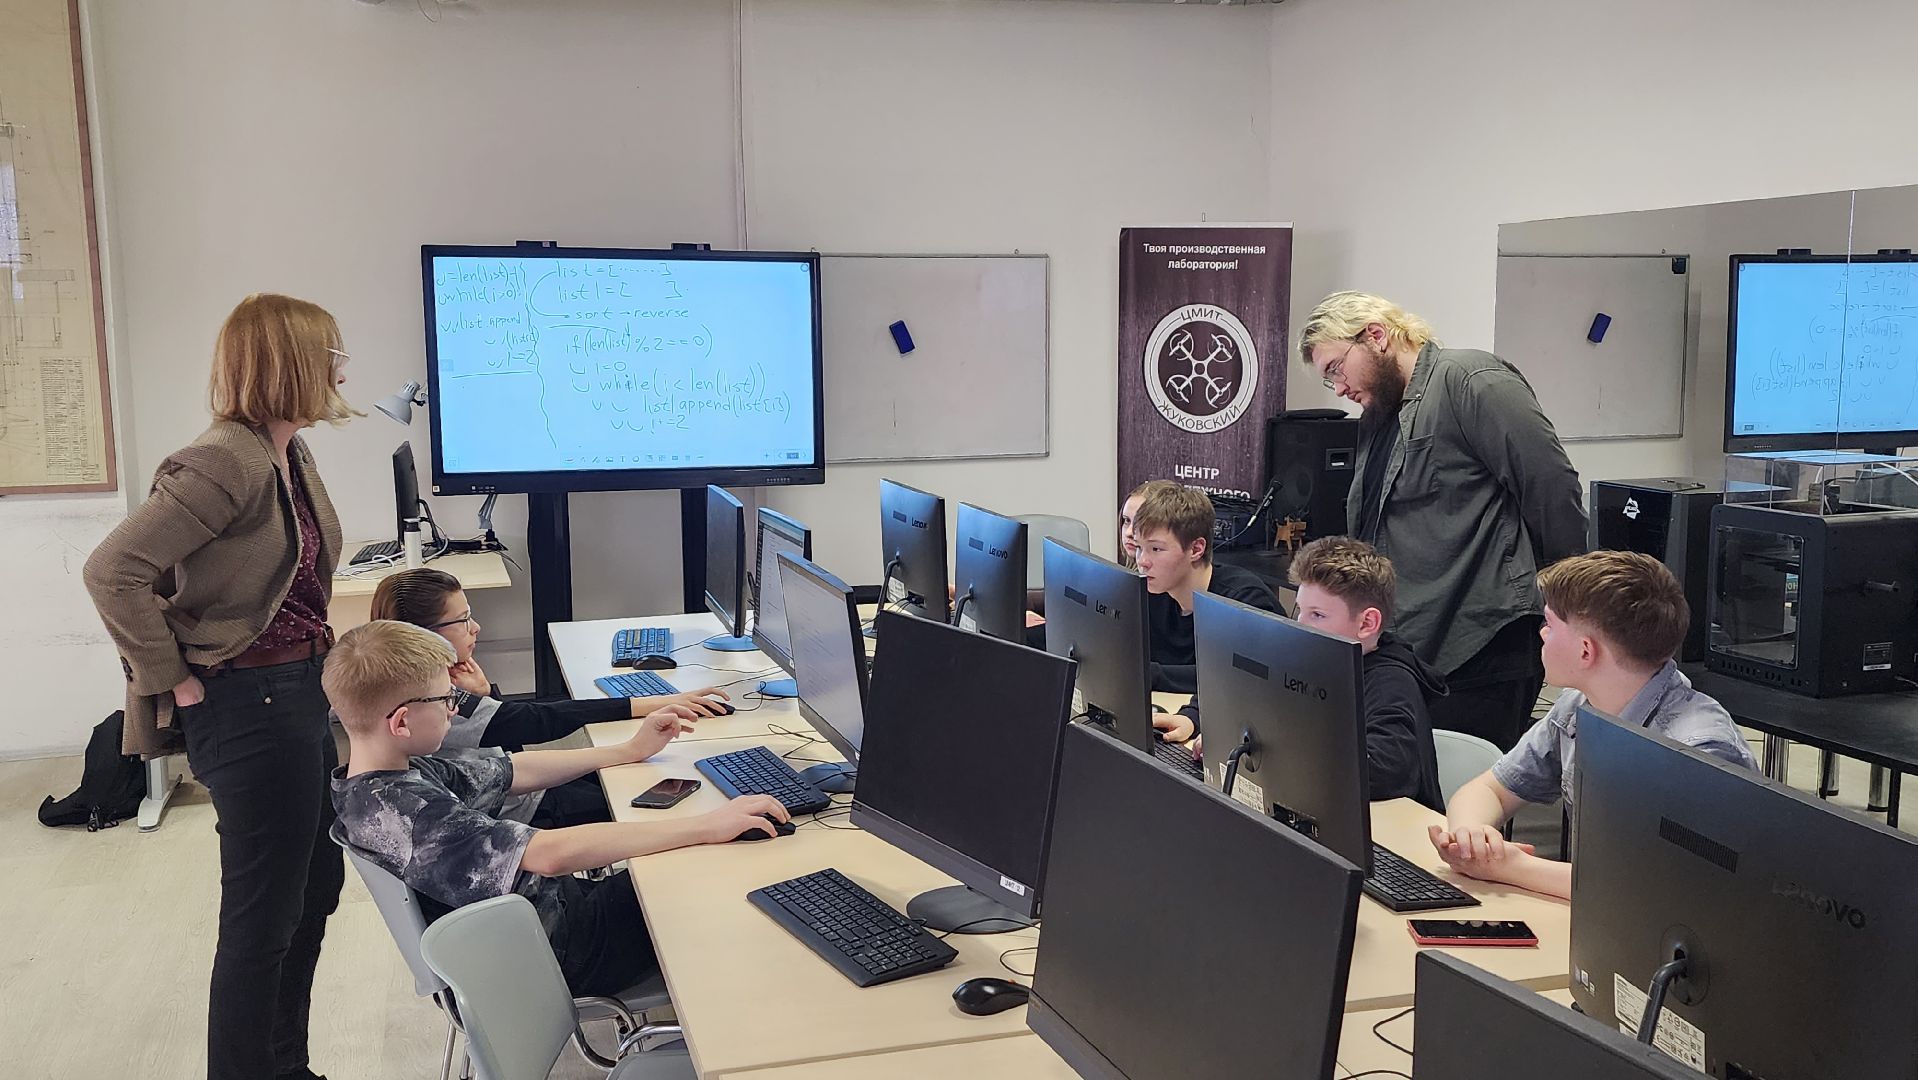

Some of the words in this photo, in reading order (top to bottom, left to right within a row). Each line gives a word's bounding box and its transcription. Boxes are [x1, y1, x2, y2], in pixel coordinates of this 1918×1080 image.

[1143, 243, 1167, 253] Твоя
[1169, 245, 1266, 255] производственная
[1168, 259, 1239, 271] лаборатория!
[576, 307, 613, 319] sort
[634, 309, 689, 318] reverse
[1180, 307, 1223, 322] ЦМИТ
[1158, 400, 1241, 430] ЖУКОВСКИЙ
[1175, 464, 1220, 479] ЦЕНТР
